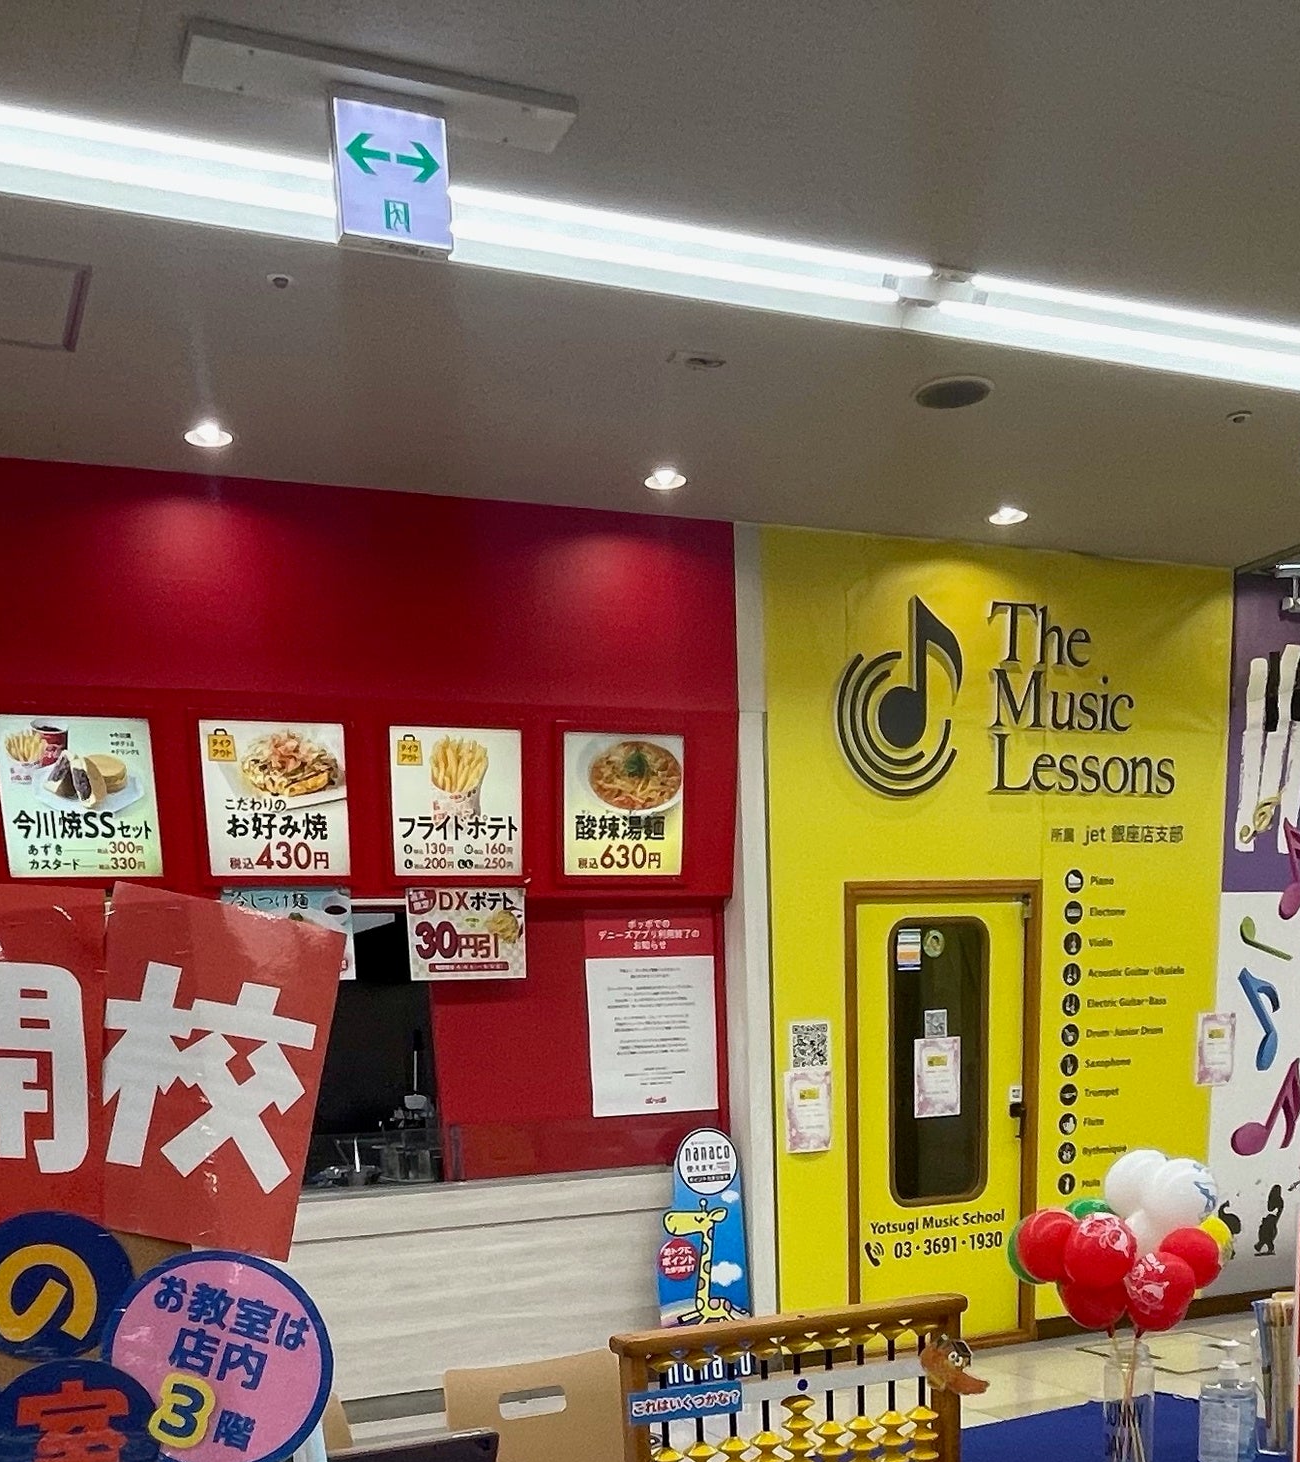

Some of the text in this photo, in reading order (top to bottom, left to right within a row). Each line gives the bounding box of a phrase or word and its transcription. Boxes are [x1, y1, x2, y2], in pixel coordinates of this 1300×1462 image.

[989, 600, 1091, 668] The
[989, 669, 1136, 733] Music
[989, 733, 1176, 796] Lessons
[225, 797, 287, 812] こだわりの
[12, 809, 153, 839] 今川焼SSセット
[226, 812, 329, 841] お好み焼
[399, 814, 518, 841] フライドポテト
[1083, 826, 1106, 848] jet
[28, 844, 64, 856] あずき
[229, 841, 330, 871] 税込430円
[578, 843, 661, 870] 税込630円
[29, 858, 81, 871] カスタード
[438, 891, 516, 911] DXポテト
[415, 920, 499, 960] 30円引
[684, 1144, 731, 1163] nanaco
[870, 1209, 1006, 1235] Yotsugi Music School
[153, 1274, 310, 1351] お教室は
[168, 1327, 268, 1391] 店内
[155, 1380, 256, 1452] 3階
[633, 1389, 740, 1416] これはいくつかな?
